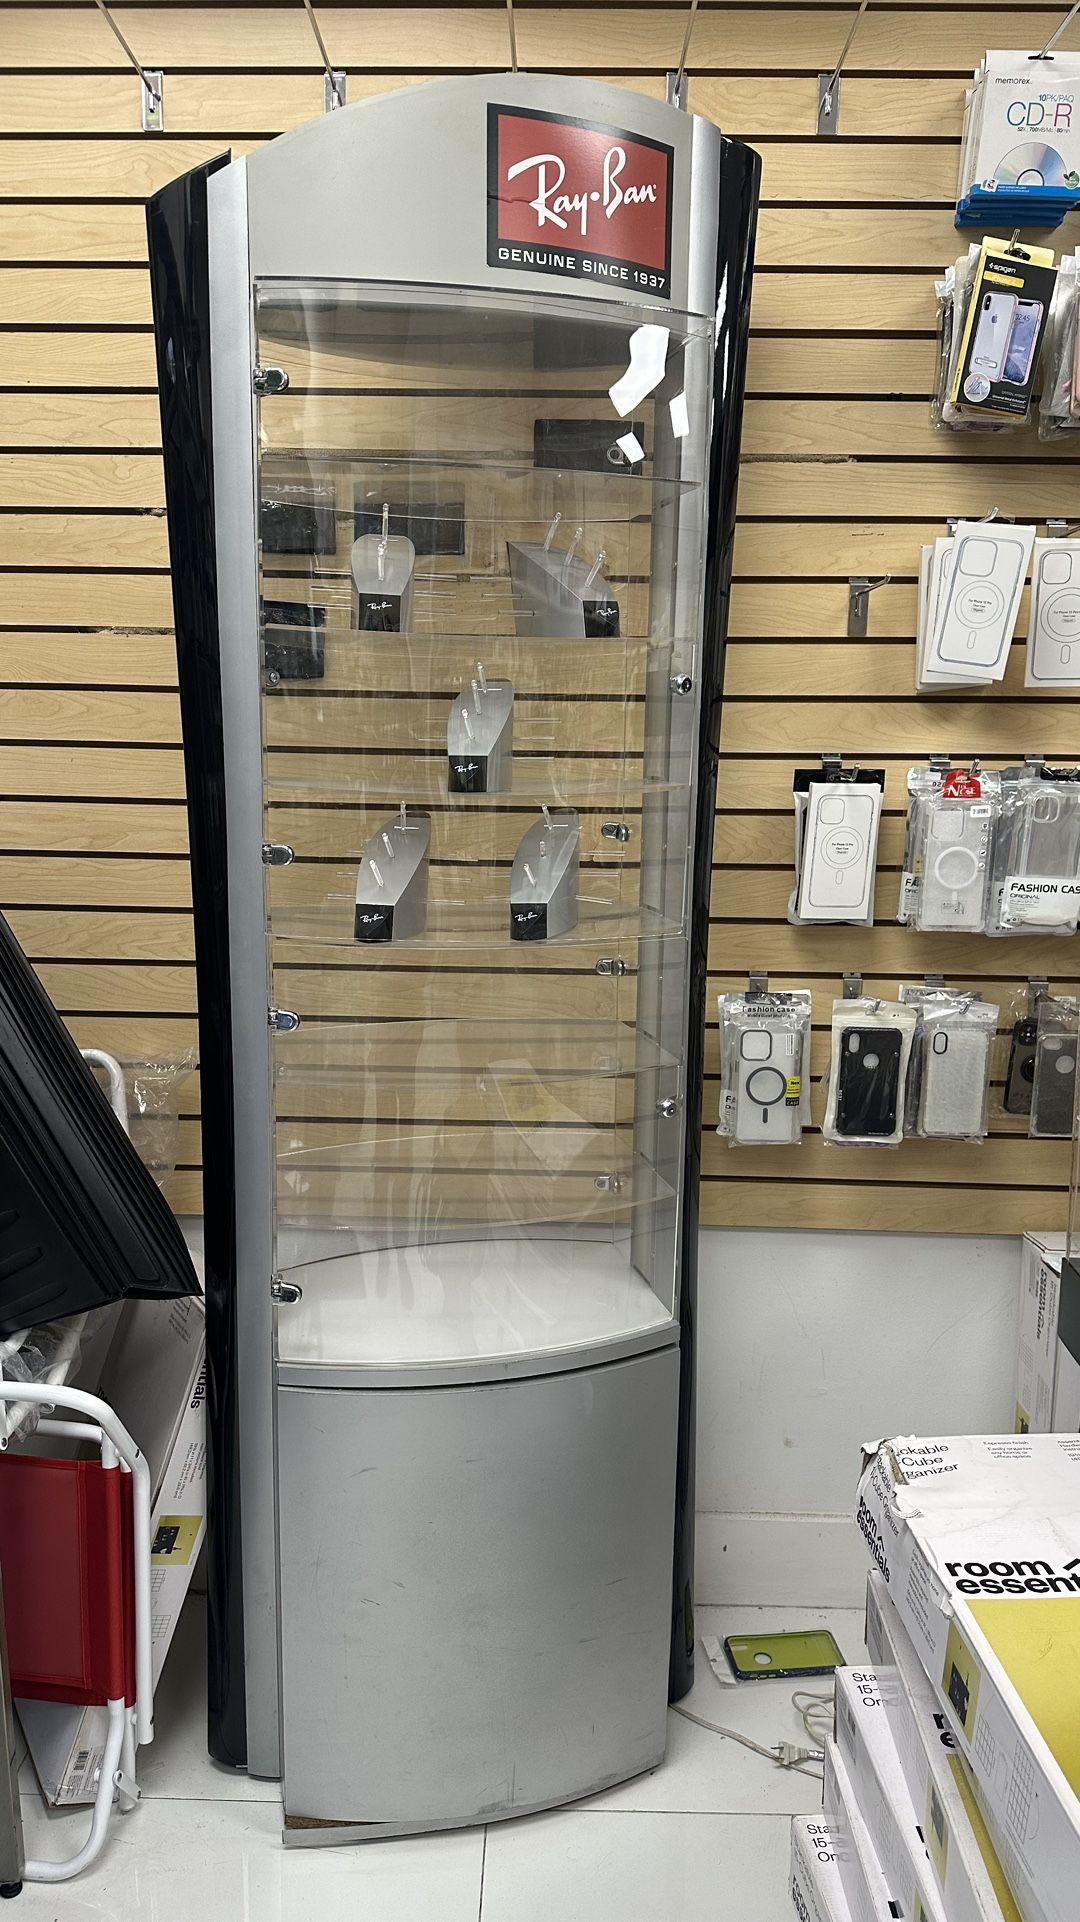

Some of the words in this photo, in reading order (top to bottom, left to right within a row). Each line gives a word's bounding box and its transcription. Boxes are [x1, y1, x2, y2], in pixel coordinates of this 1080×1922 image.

[1007, 102, 1072, 127] CD-R
[498, 248, 576, 270] GENUINE
[582, 260, 629, 280] SINCE
[633, 272, 666, 289] 1937
[994, 264, 1016, 274] spigen
[1011, 883, 1057, 893] FASHION
[1061, 885, 1080, 894] CAS
[860, 1496, 878, 1536] room
[857, 1510, 890, 1583] essentials
[945, 1559, 1056, 1576] room
[956, 1573, 1080, 1594] essent
[852, 1673, 877, 1682] Sta
[857, 1685, 878, 1694] 15-
[863, 1697, 882, 1707] Or
[807, 1824, 829, 1834] Sta
[812, 1838, 834, 1848] 15-
